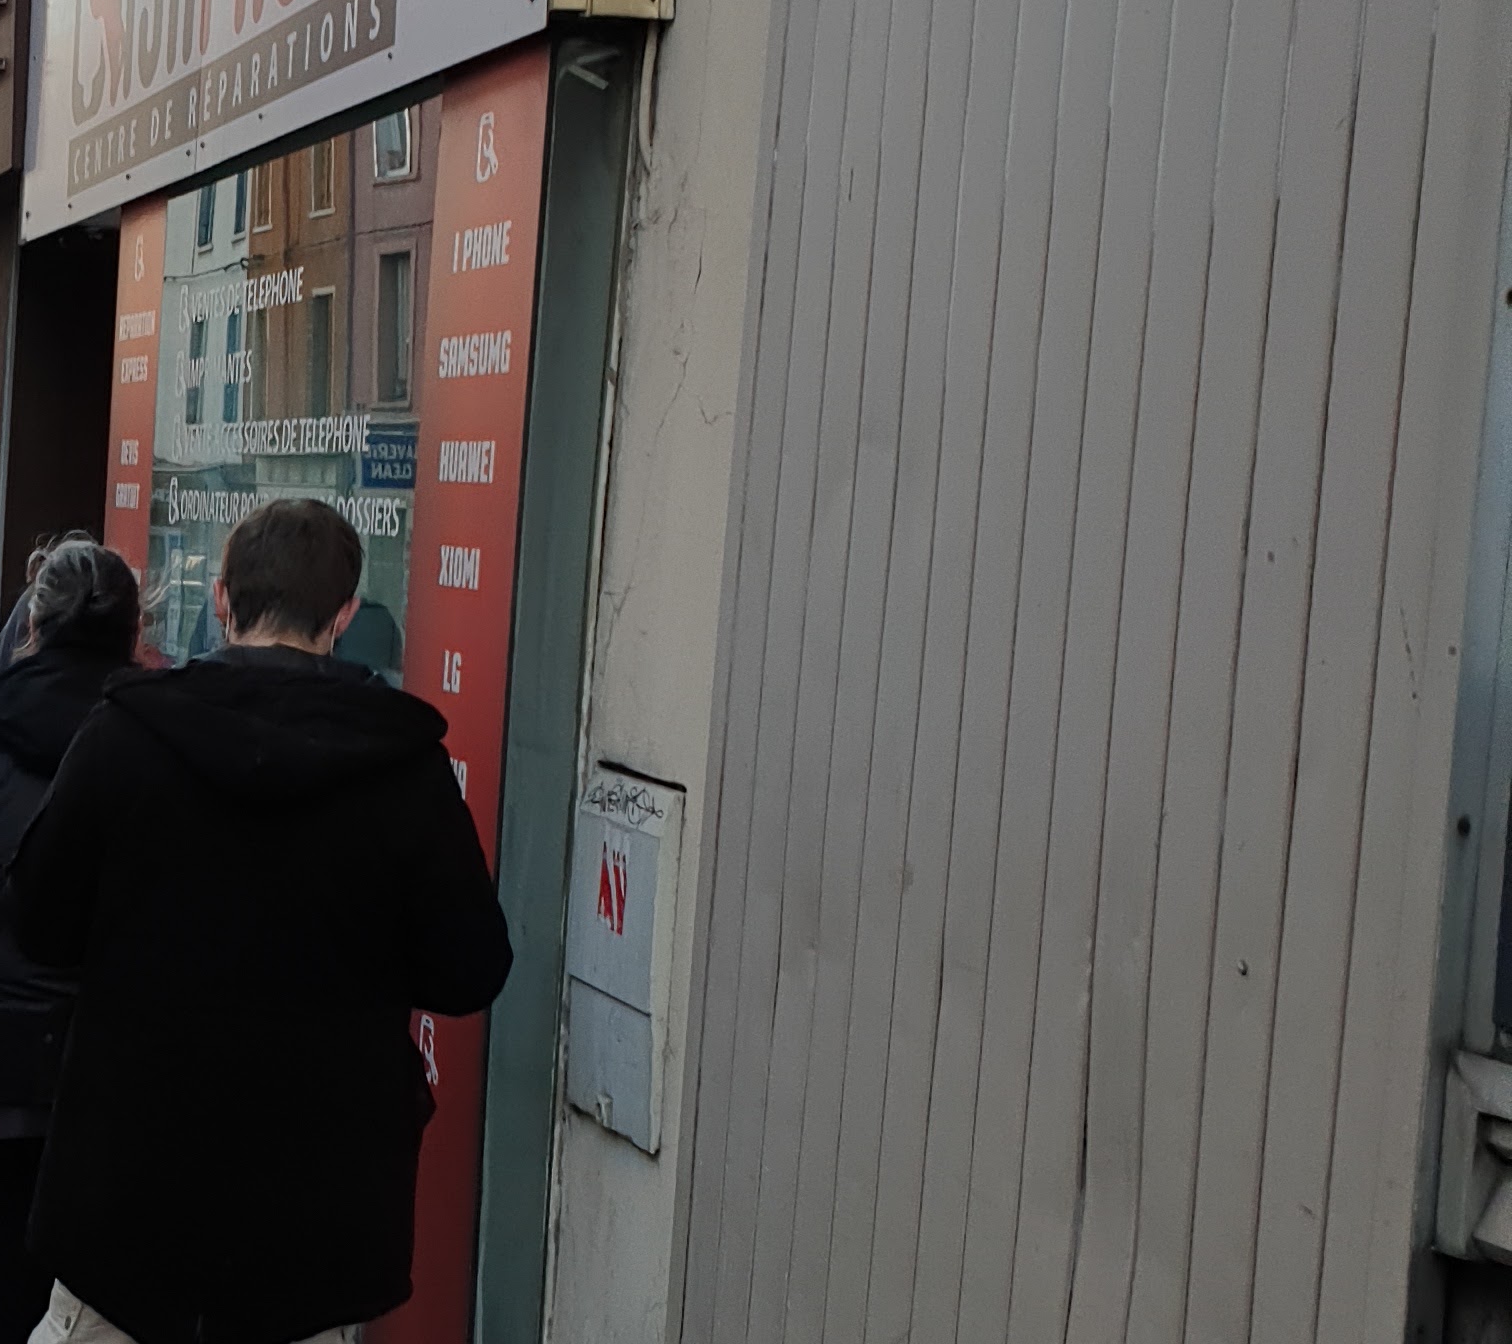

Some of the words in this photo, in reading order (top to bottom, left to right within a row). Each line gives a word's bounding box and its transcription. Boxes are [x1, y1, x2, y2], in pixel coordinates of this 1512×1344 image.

[73, 119, 138, 185] CENTRE
[150, 100, 173, 146] DE
[461, 220, 512, 273] PHONE
[242, 266, 305, 313] TELEPHONE
[281, 419, 298, 454] DE
[299, 414, 371, 454] TELEPHONE
[439, 440, 496, 484] HUAWEI
[180, 489, 239, 525] ORDINATEUR
[439, 544, 480, 591] XIOMI
[442, 649, 462, 694] LG
